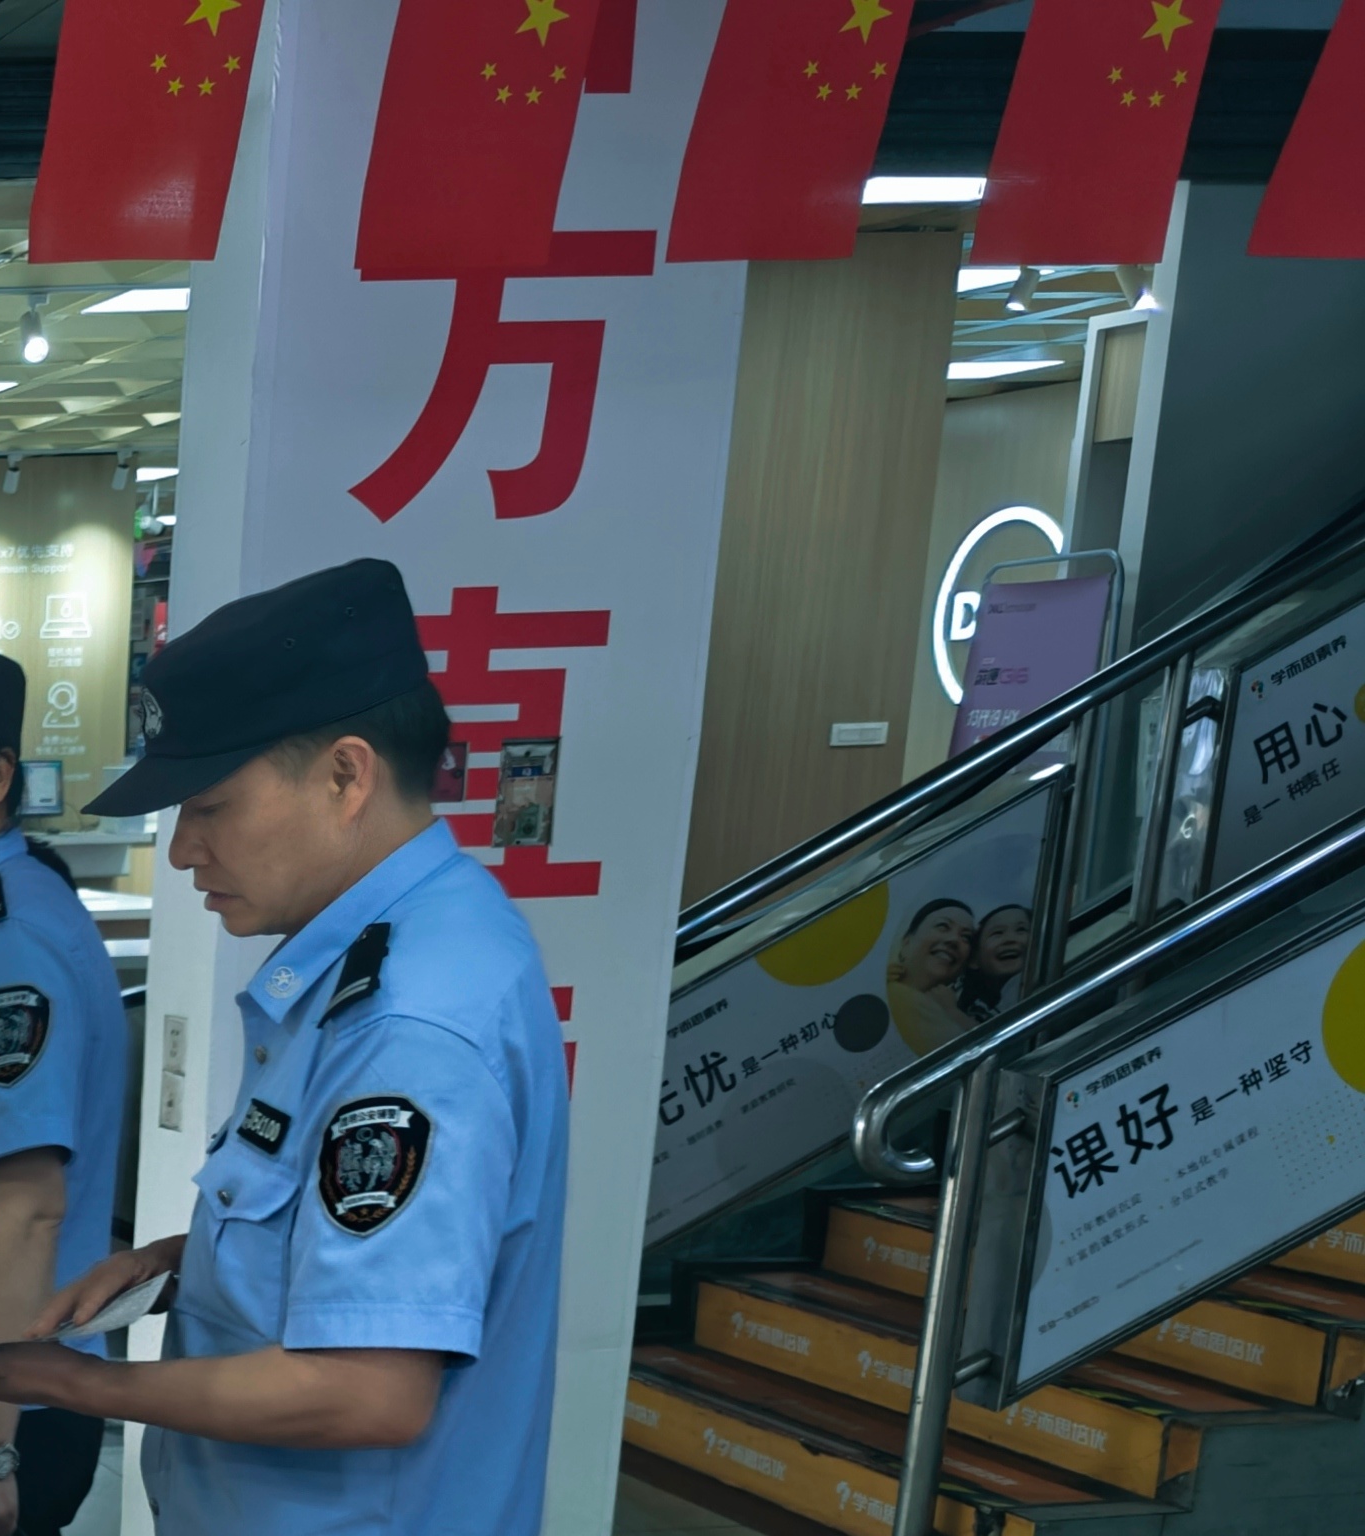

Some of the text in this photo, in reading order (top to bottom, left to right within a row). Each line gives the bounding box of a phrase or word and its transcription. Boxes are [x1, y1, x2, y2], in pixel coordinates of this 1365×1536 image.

[1270, 635, 1347, 686] 学而思素养
[1253, 702, 1348, 785] 用心
[1243, 757, 1342, 828] 是一种责任
[741, 1012, 839, 1078] 是一种初心
[1085, 1046, 1163, 1096] 学而思素养
[1049, 1040, 1313, 1199] 课好 是一种坚守
[1173, 1321, 1266, 1366] 学而思培优
[1021, 1407, 1108, 1453] 学而思培优
